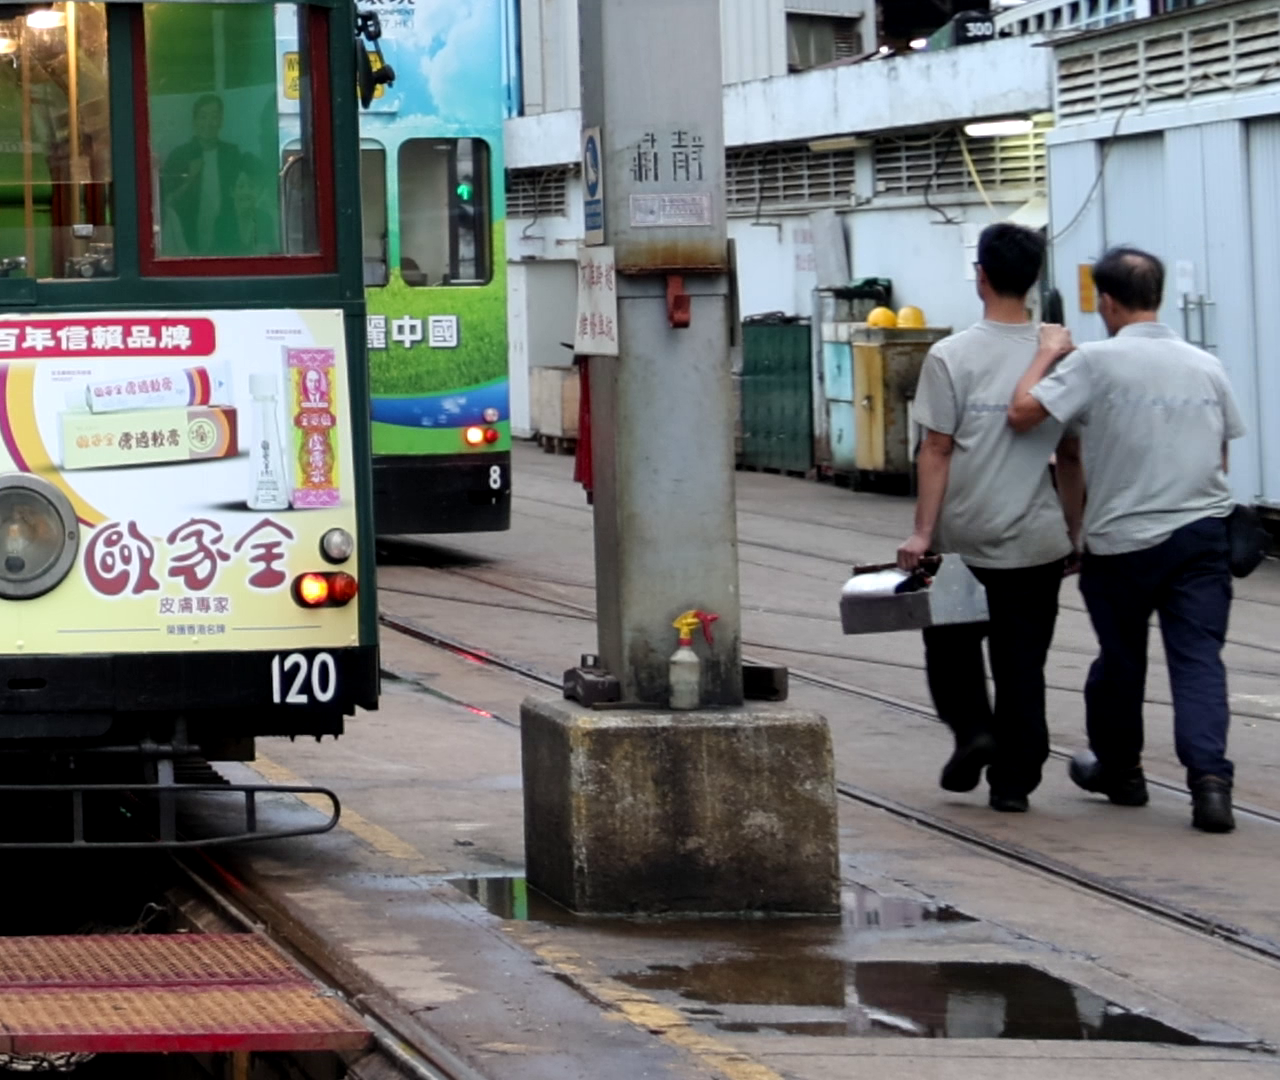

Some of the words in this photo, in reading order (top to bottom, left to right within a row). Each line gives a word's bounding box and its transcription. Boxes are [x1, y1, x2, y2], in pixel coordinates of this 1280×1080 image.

[966, 22, 993, 37] 300
[489, 465, 501, 489] 8
[159, 597, 229, 614] 皮膚專家
[271, 652, 337, 703] 120
